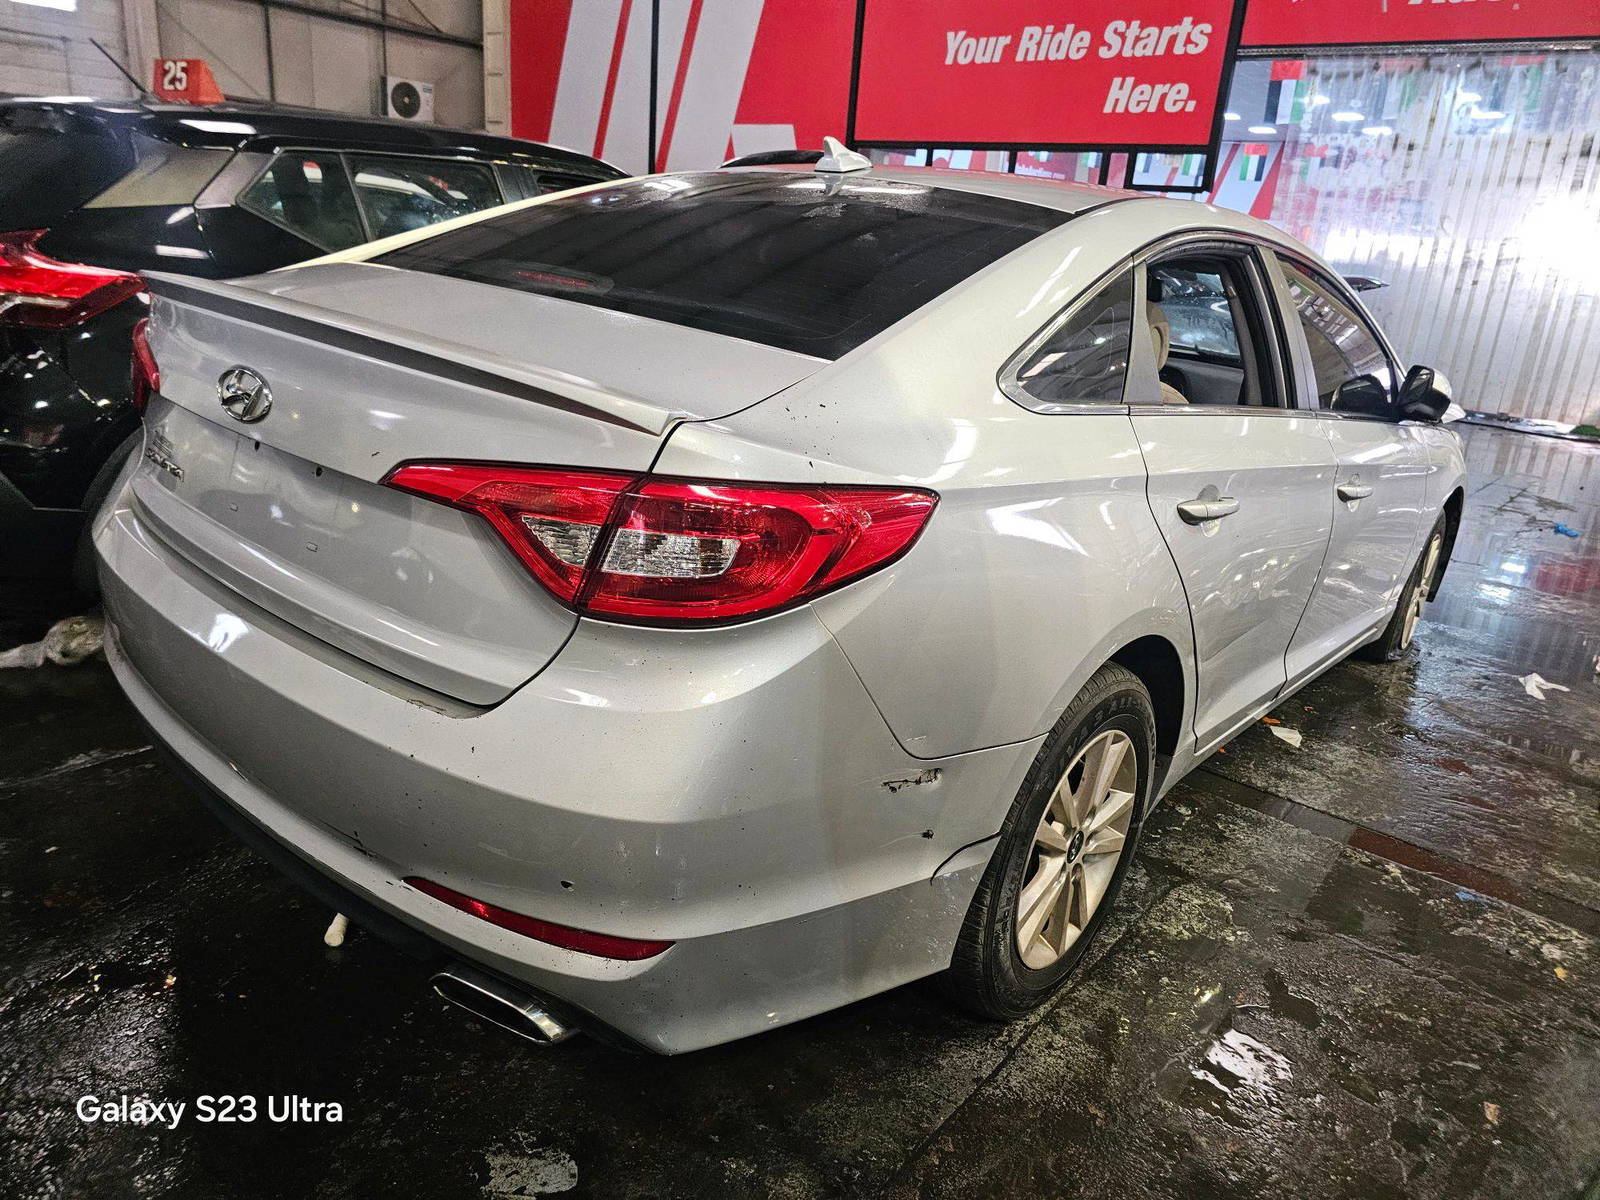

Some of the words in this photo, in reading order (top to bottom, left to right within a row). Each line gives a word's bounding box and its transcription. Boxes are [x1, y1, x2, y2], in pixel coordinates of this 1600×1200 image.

[945, 30, 1011, 65] Your
[1015, 24, 1091, 62] Ride
[1098, 16, 1212, 59] Starts
[163, 60, 188, 91] 25
[1103, 77, 1197, 114] Here.
